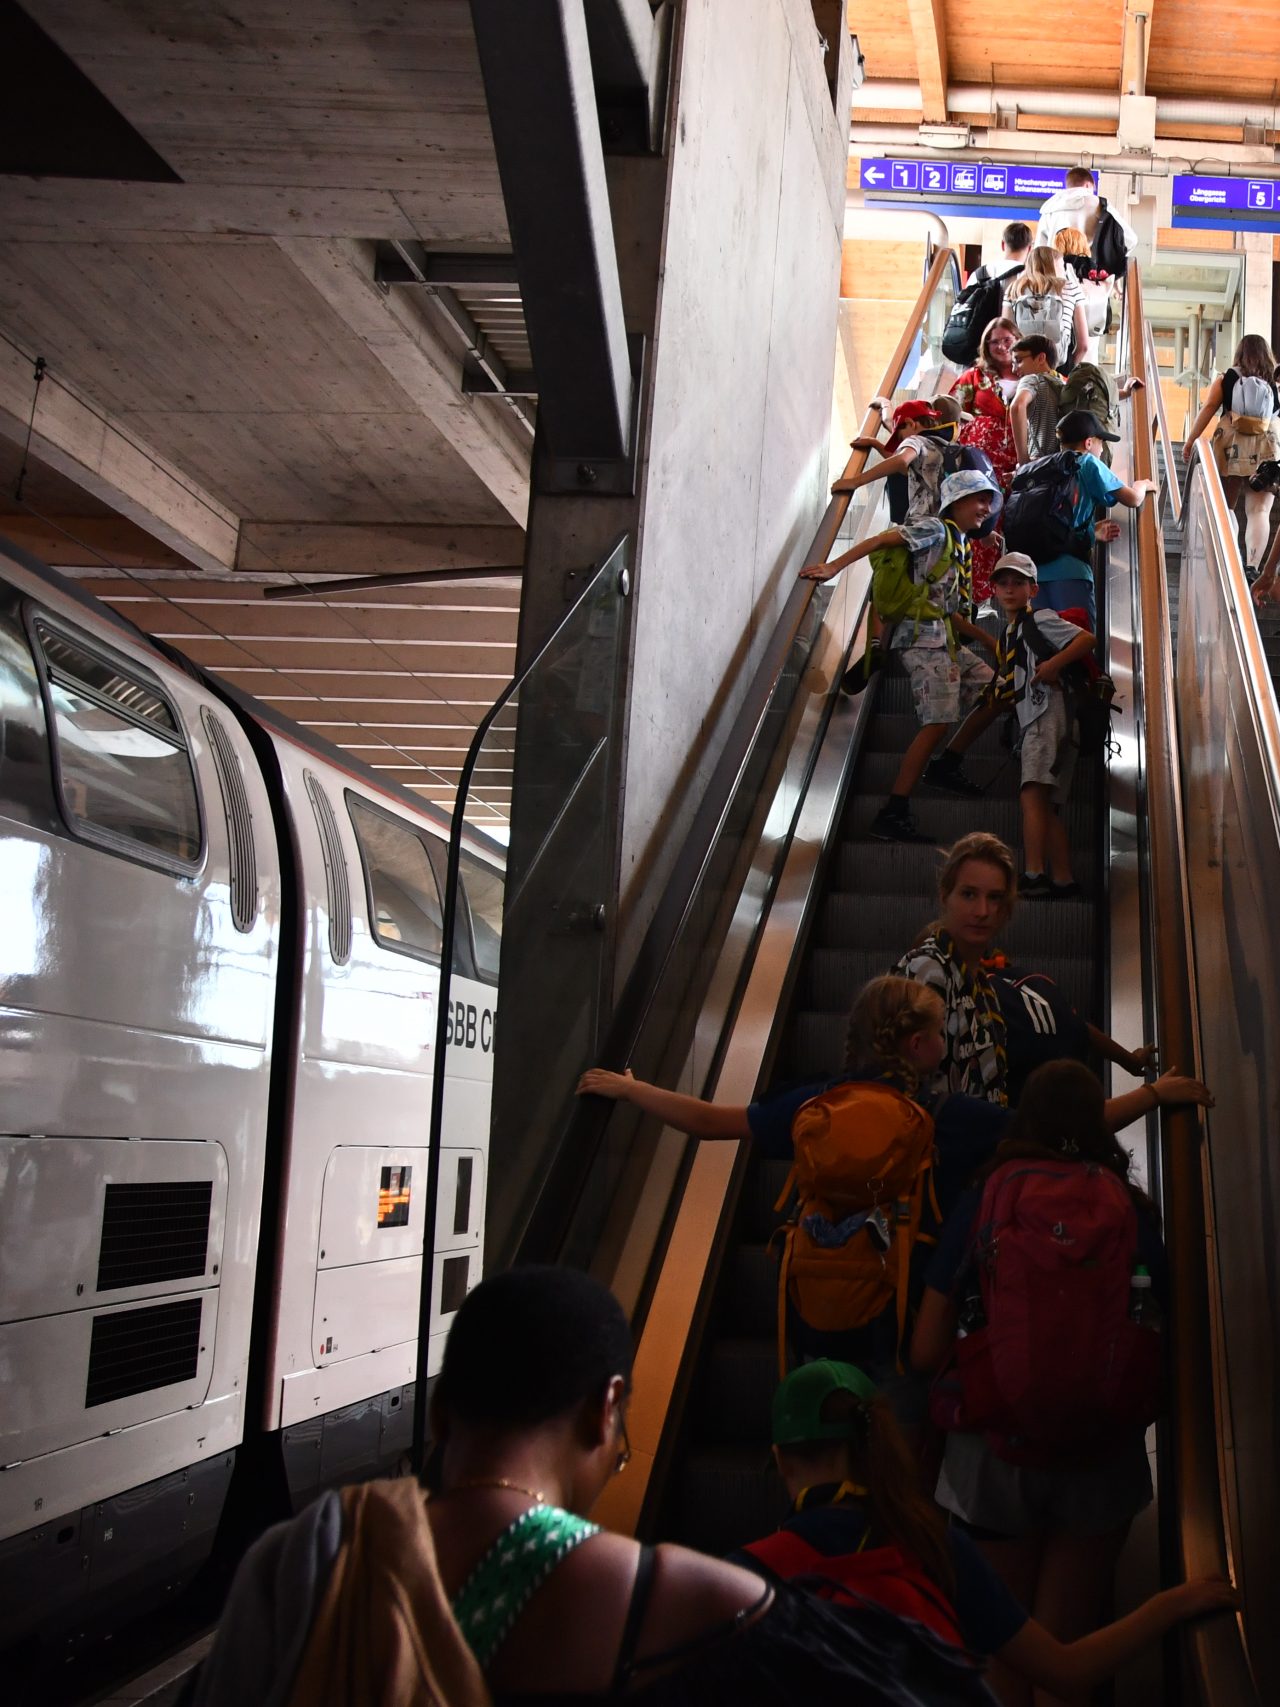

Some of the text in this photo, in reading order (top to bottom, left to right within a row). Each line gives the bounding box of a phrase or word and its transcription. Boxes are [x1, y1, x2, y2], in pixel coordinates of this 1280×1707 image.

[900, 170, 940, 187] 1 2
[1255, 192, 1265, 206] 5
